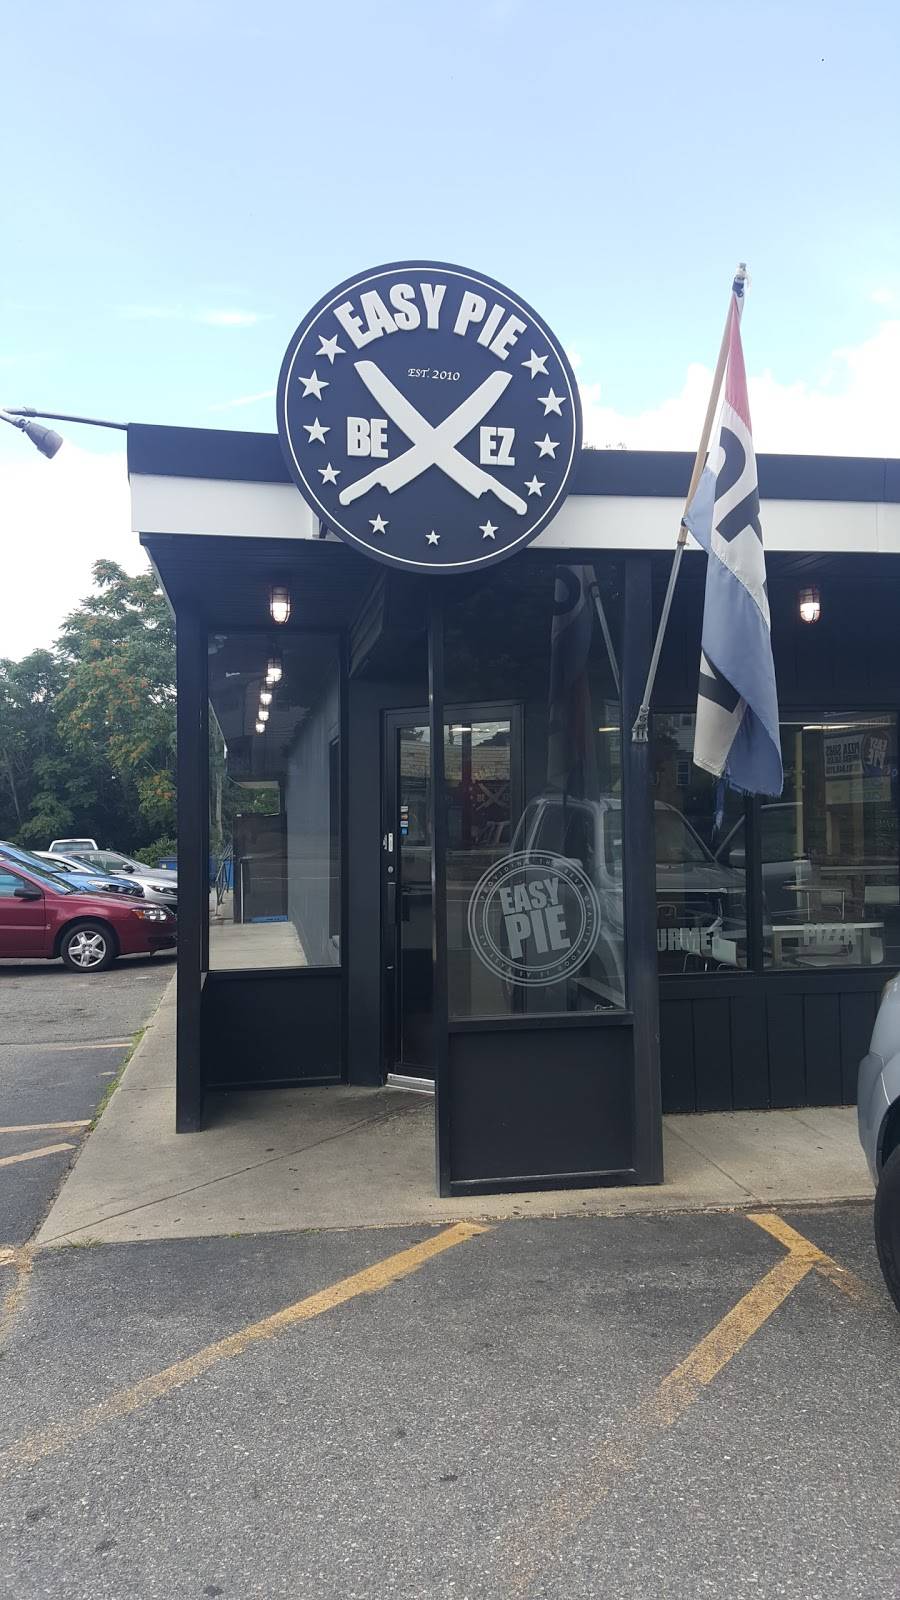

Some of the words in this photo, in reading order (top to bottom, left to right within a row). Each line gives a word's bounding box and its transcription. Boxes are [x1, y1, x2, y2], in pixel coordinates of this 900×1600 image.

[333, 283, 447, 350] EASY
[453, 290, 527, 361] PIE
[408, 368, 430, 378] EST.
[432, 370, 460, 381] 2010
[347, 416, 389, 458] BE
[479, 426, 516, 466] EZ
[500, 877, 559, 915] EASY
[504, 905, 571, 959] PIE
